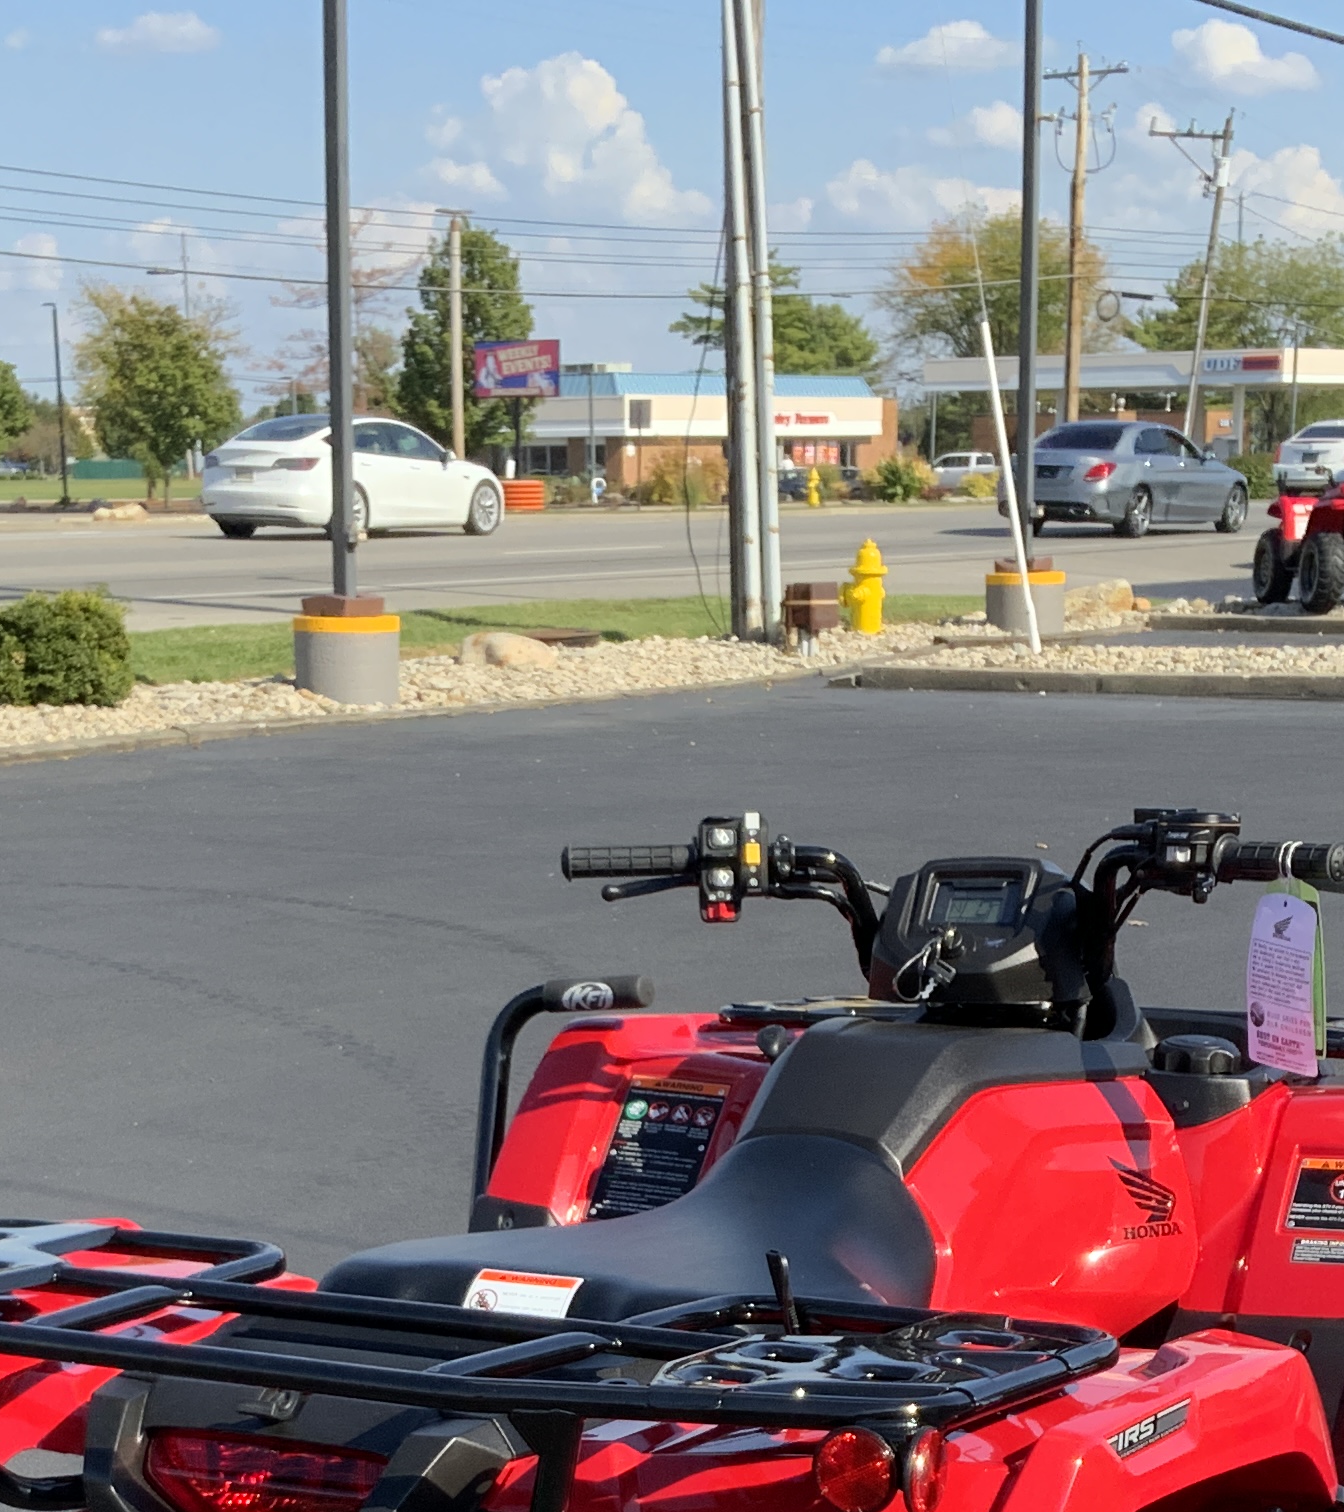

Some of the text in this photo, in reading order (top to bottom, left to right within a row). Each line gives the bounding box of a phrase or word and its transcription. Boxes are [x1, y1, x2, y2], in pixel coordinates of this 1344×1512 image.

[663, 1080, 704, 1092] WARNING
[1123, 1222, 1183, 1240] HONDA
[512, 1275, 558, 1285] WARNING
[1118, 1414, 1156, 1452] IRS
